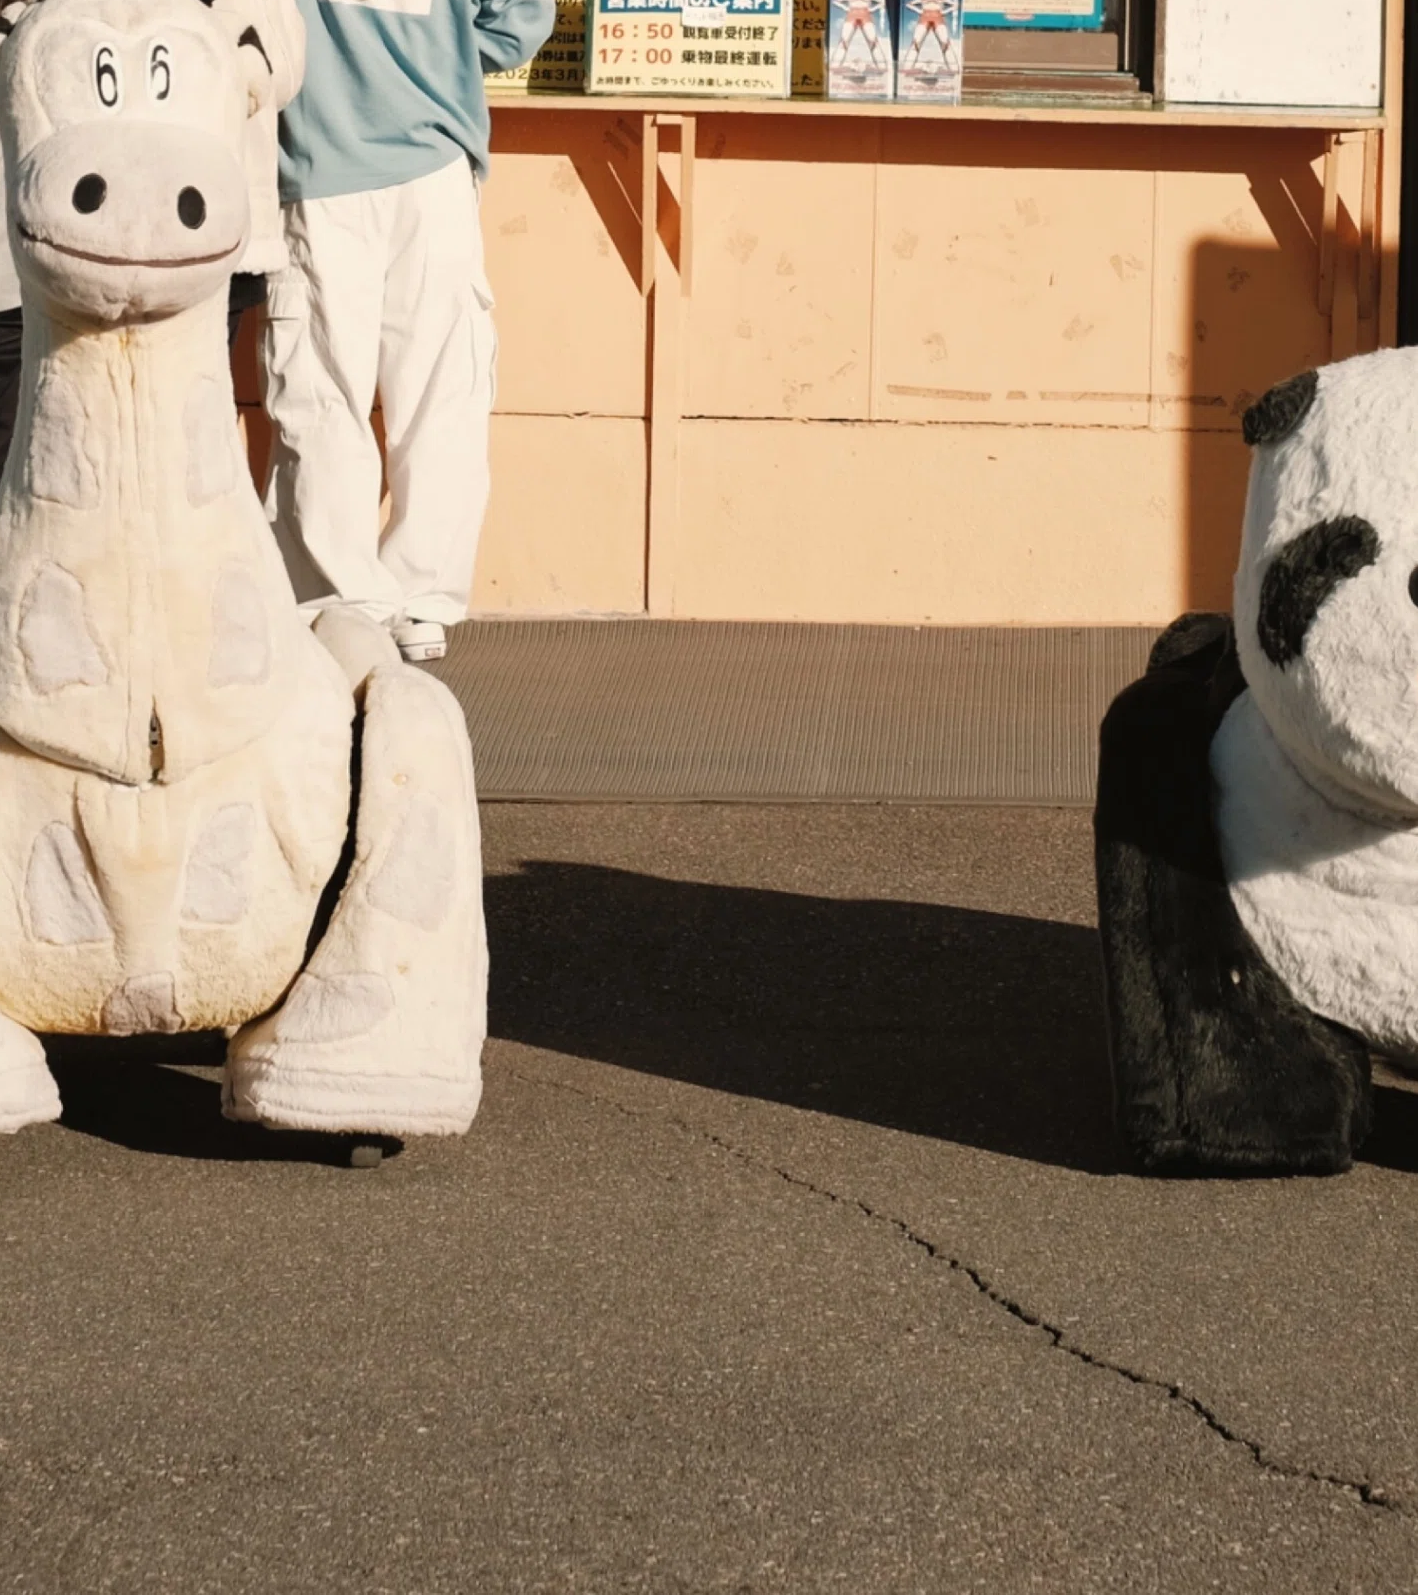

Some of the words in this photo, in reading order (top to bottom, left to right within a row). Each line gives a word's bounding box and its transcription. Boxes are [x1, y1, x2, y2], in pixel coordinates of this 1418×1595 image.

[682, 25, 779, 42] 観覧車受付終了
[680, 49, 779, 67] 乗物最終運転
